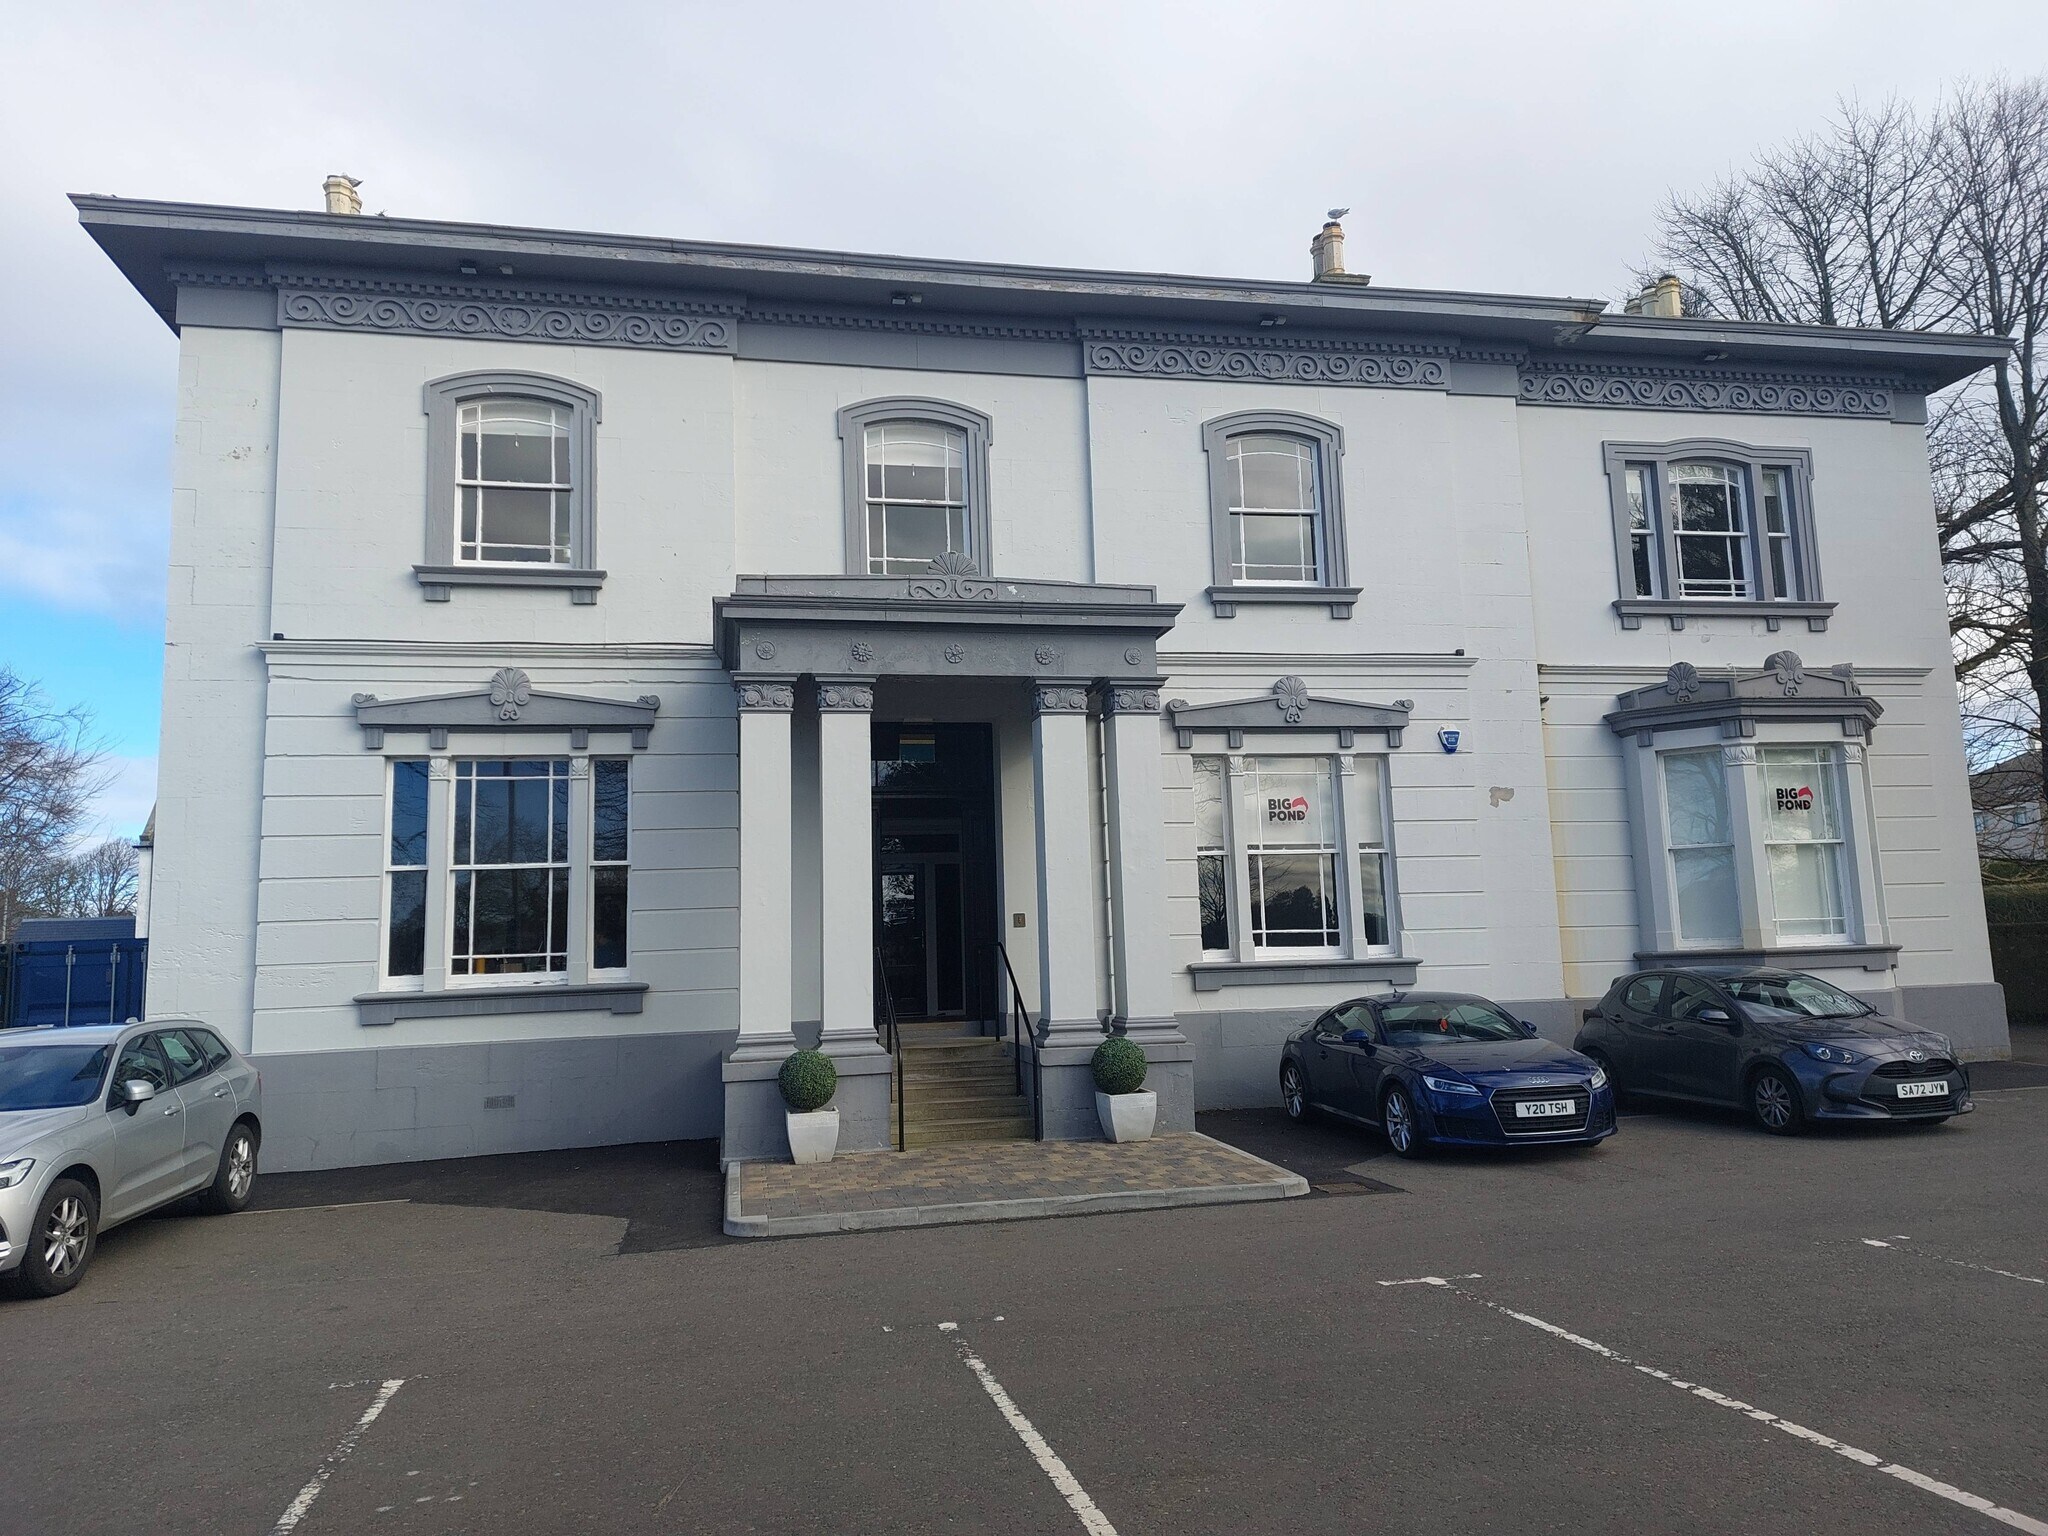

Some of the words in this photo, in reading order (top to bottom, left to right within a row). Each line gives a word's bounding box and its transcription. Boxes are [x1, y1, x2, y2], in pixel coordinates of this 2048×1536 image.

[1776, 788, 1798, 800] BIG
[1268, 798, 1292, 810] BIG
[1777, 800, 1811, 811] POND
[1269, 810, 1306, 821] POND
[1902, 1084, 1926, 1096] SA72
[1929, 1083, 1945, 1094] JYW
[1525, 1103, 1546, 1115] Y20
[1548, 1102, 1568, 1114] TSH
